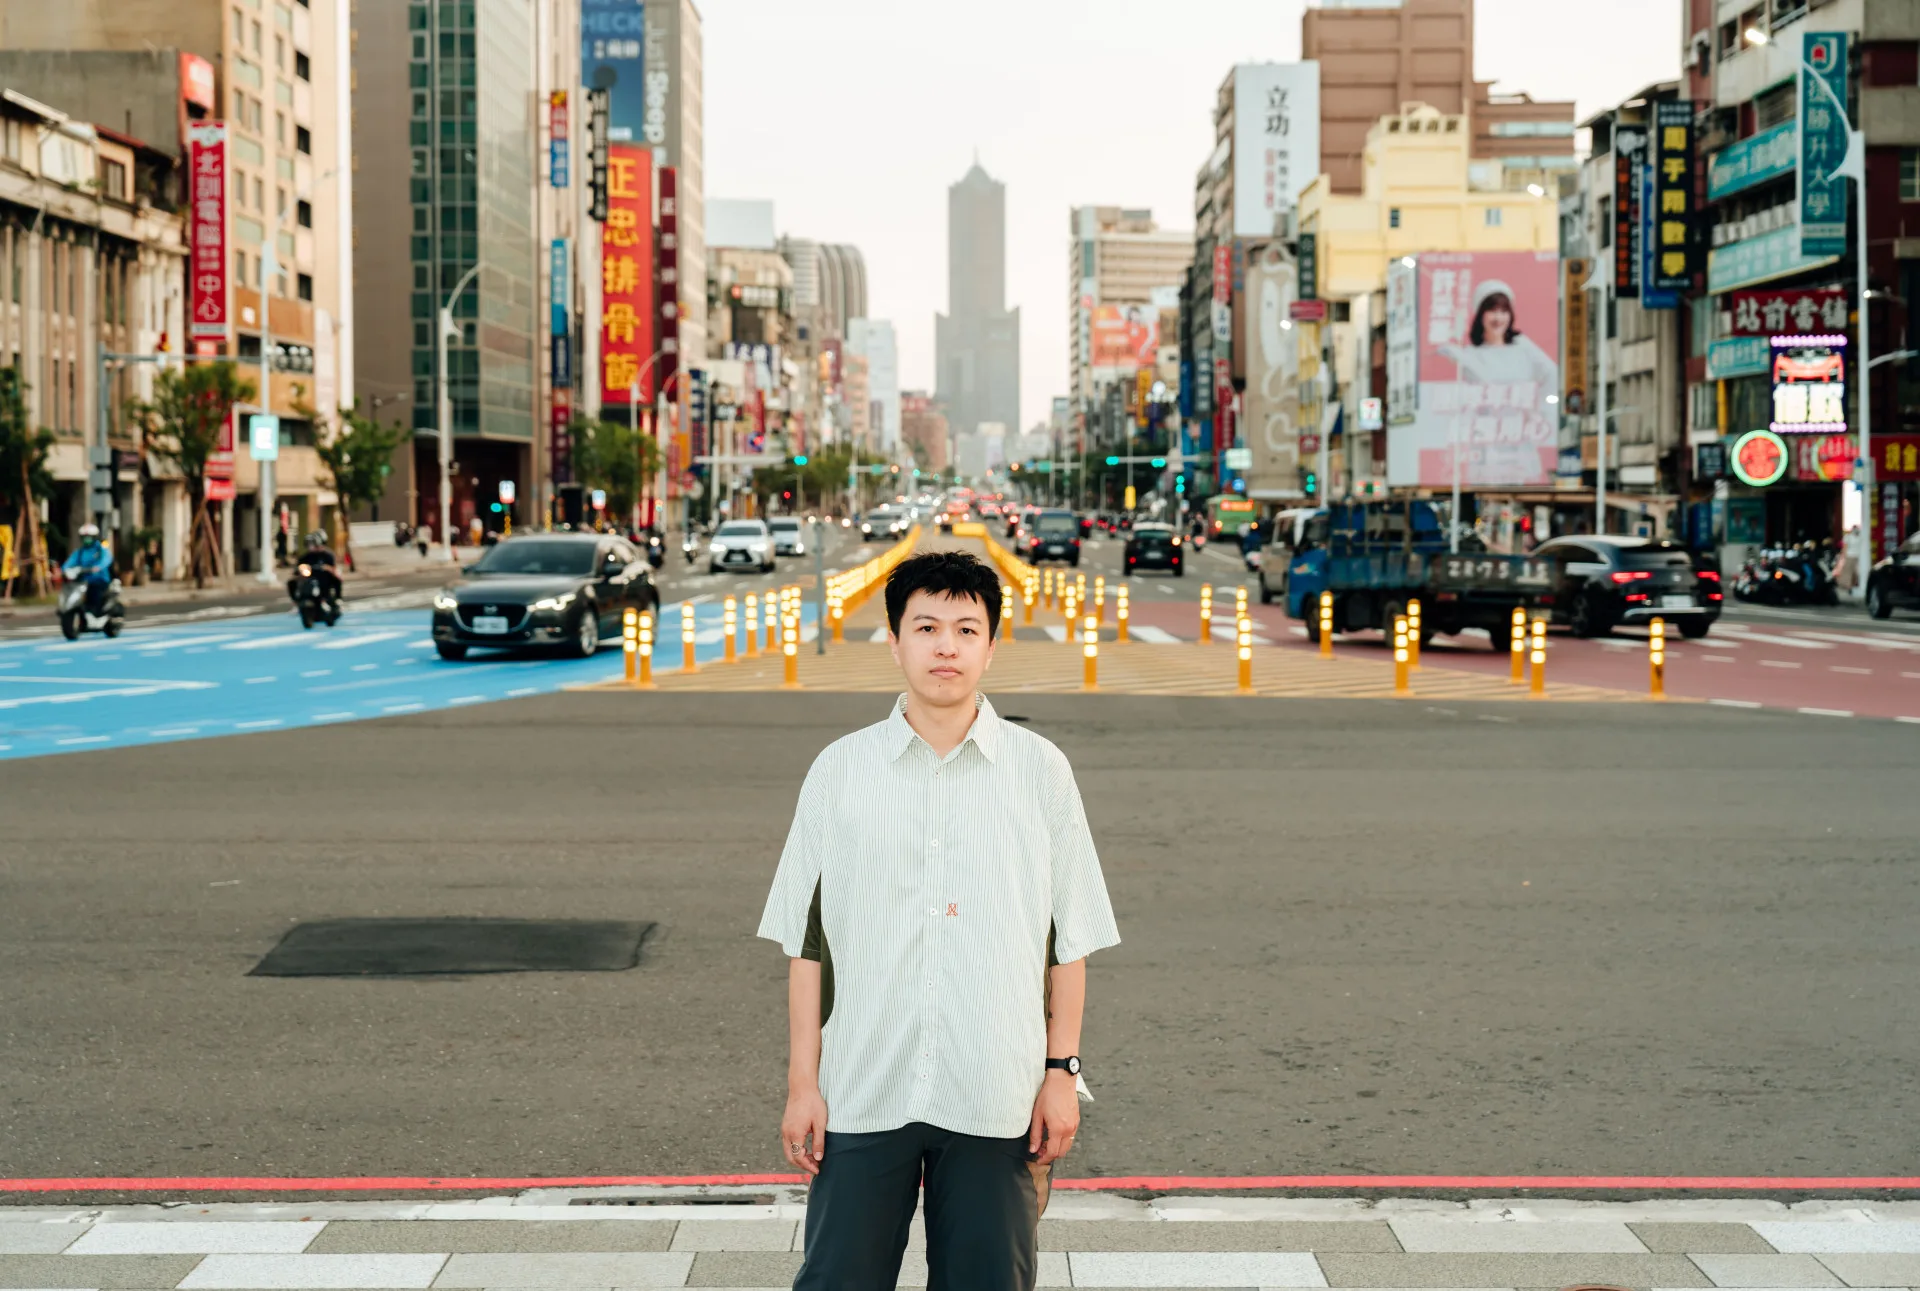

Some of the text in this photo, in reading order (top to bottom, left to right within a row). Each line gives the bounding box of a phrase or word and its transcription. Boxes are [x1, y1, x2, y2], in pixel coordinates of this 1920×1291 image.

[1264, 85, 1290, 136] 立功
[604, 156, 640, 391] 正忠排骨飯
